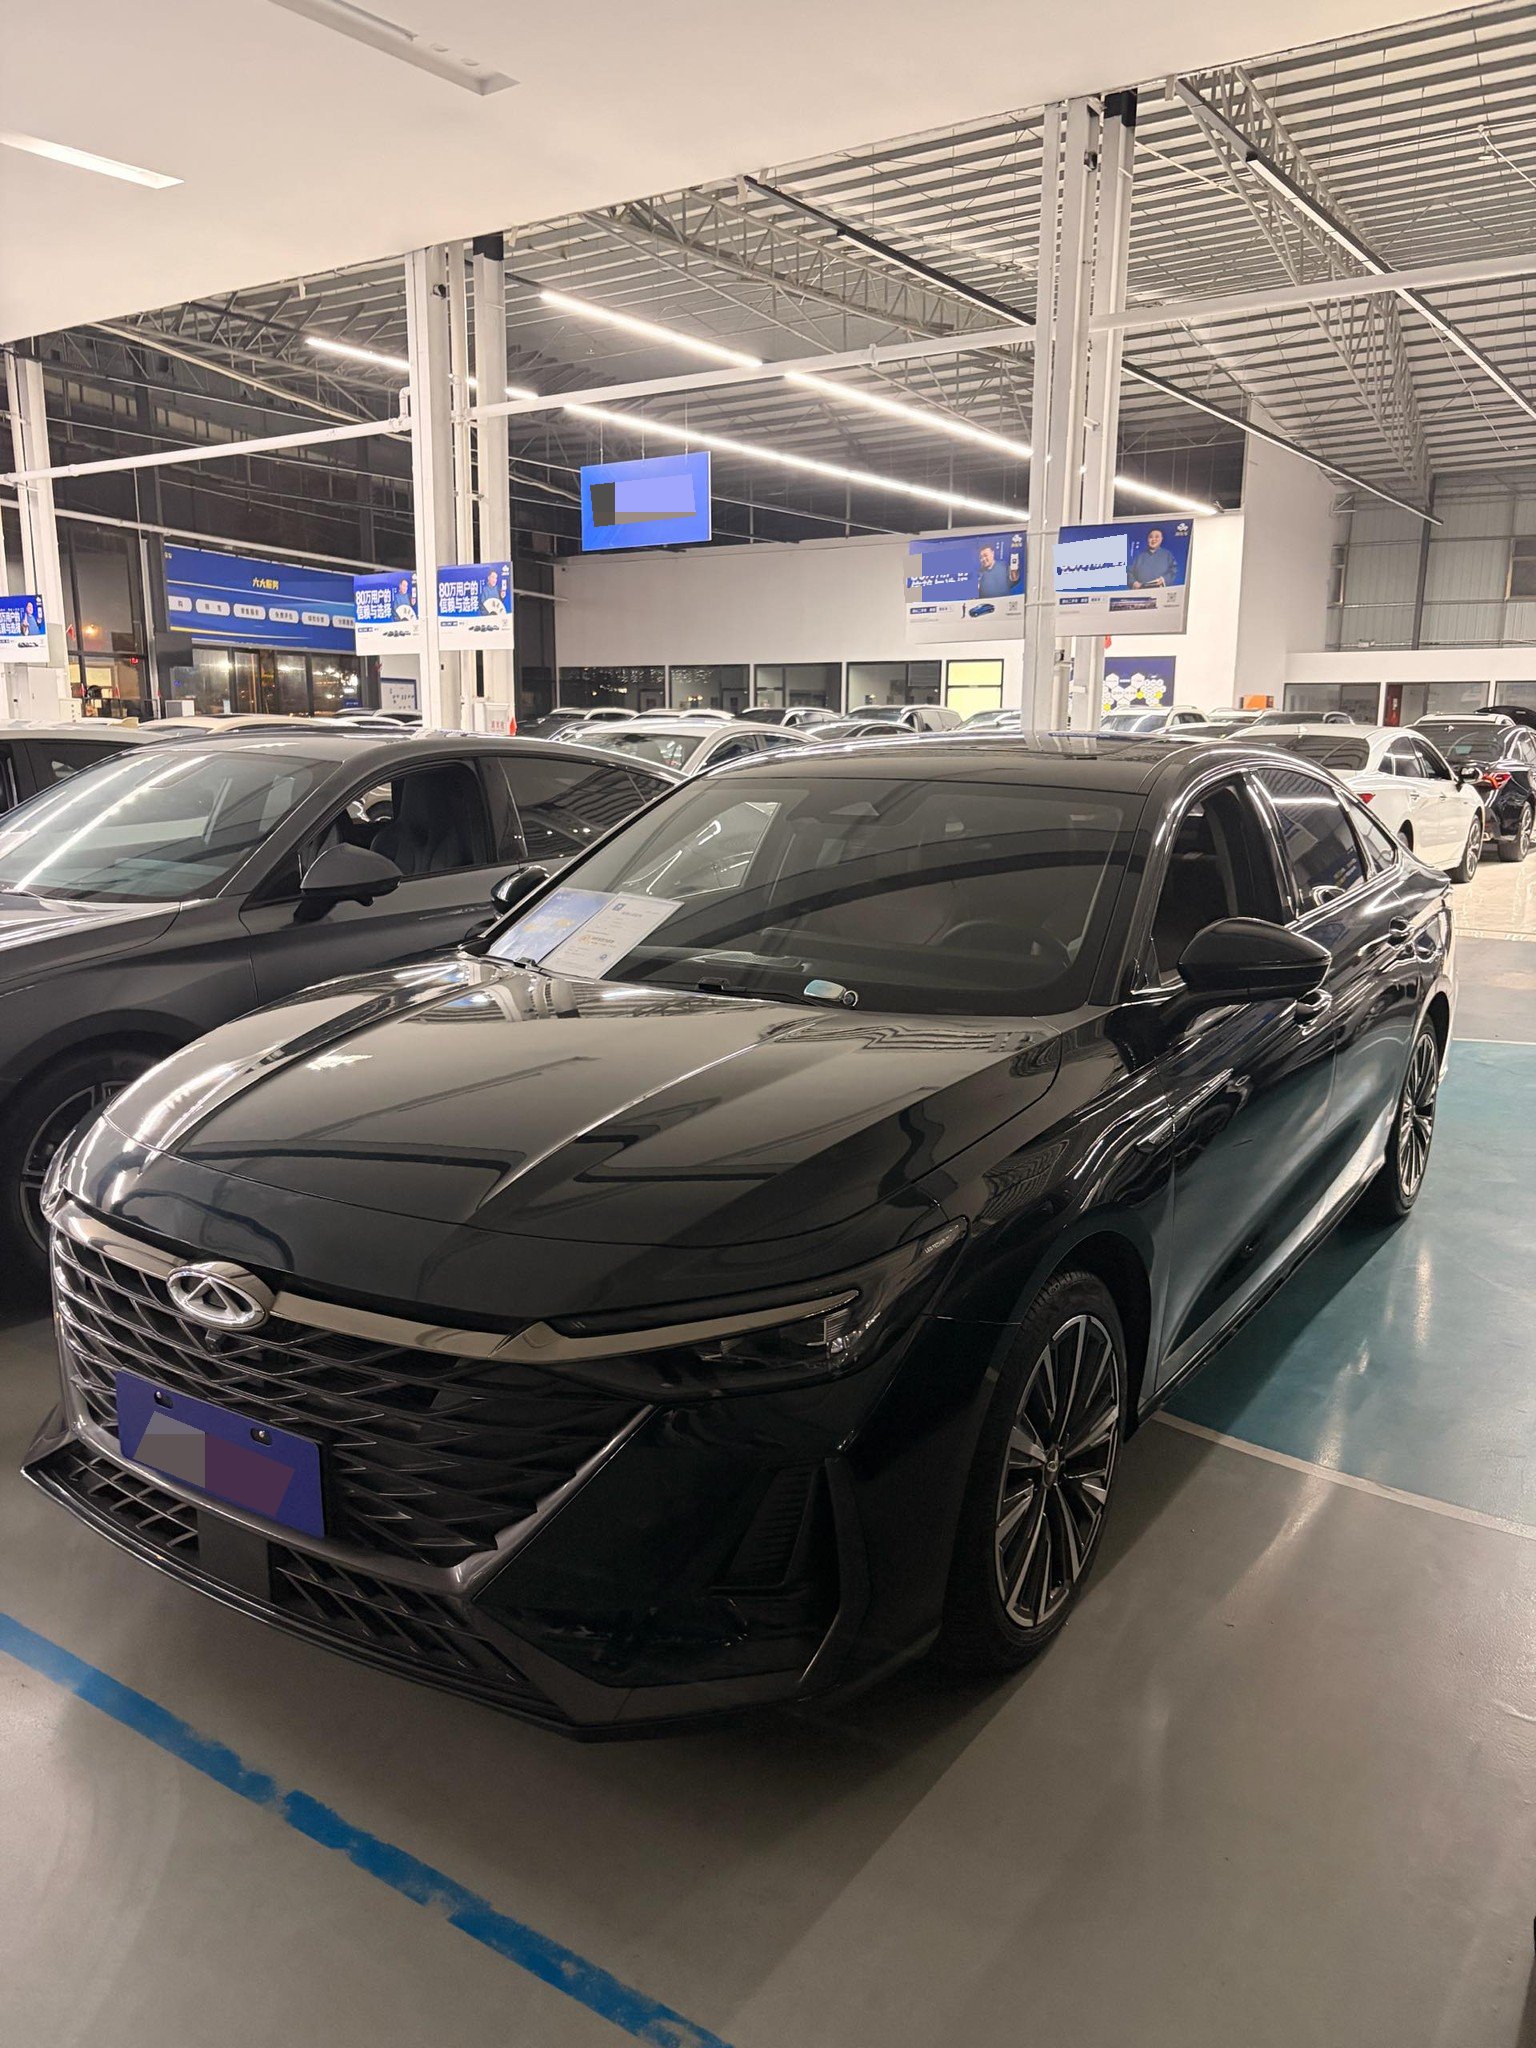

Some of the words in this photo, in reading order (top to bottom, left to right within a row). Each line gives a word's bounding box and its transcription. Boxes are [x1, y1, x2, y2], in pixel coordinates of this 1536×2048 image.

[355, 589, 391, 604] 80万用户的
[439, 580, 478, 597] 80万用户的
[356, 603, 392, 620] 信赖与选择
[439, 596, 479, 613] 信赖与选择
